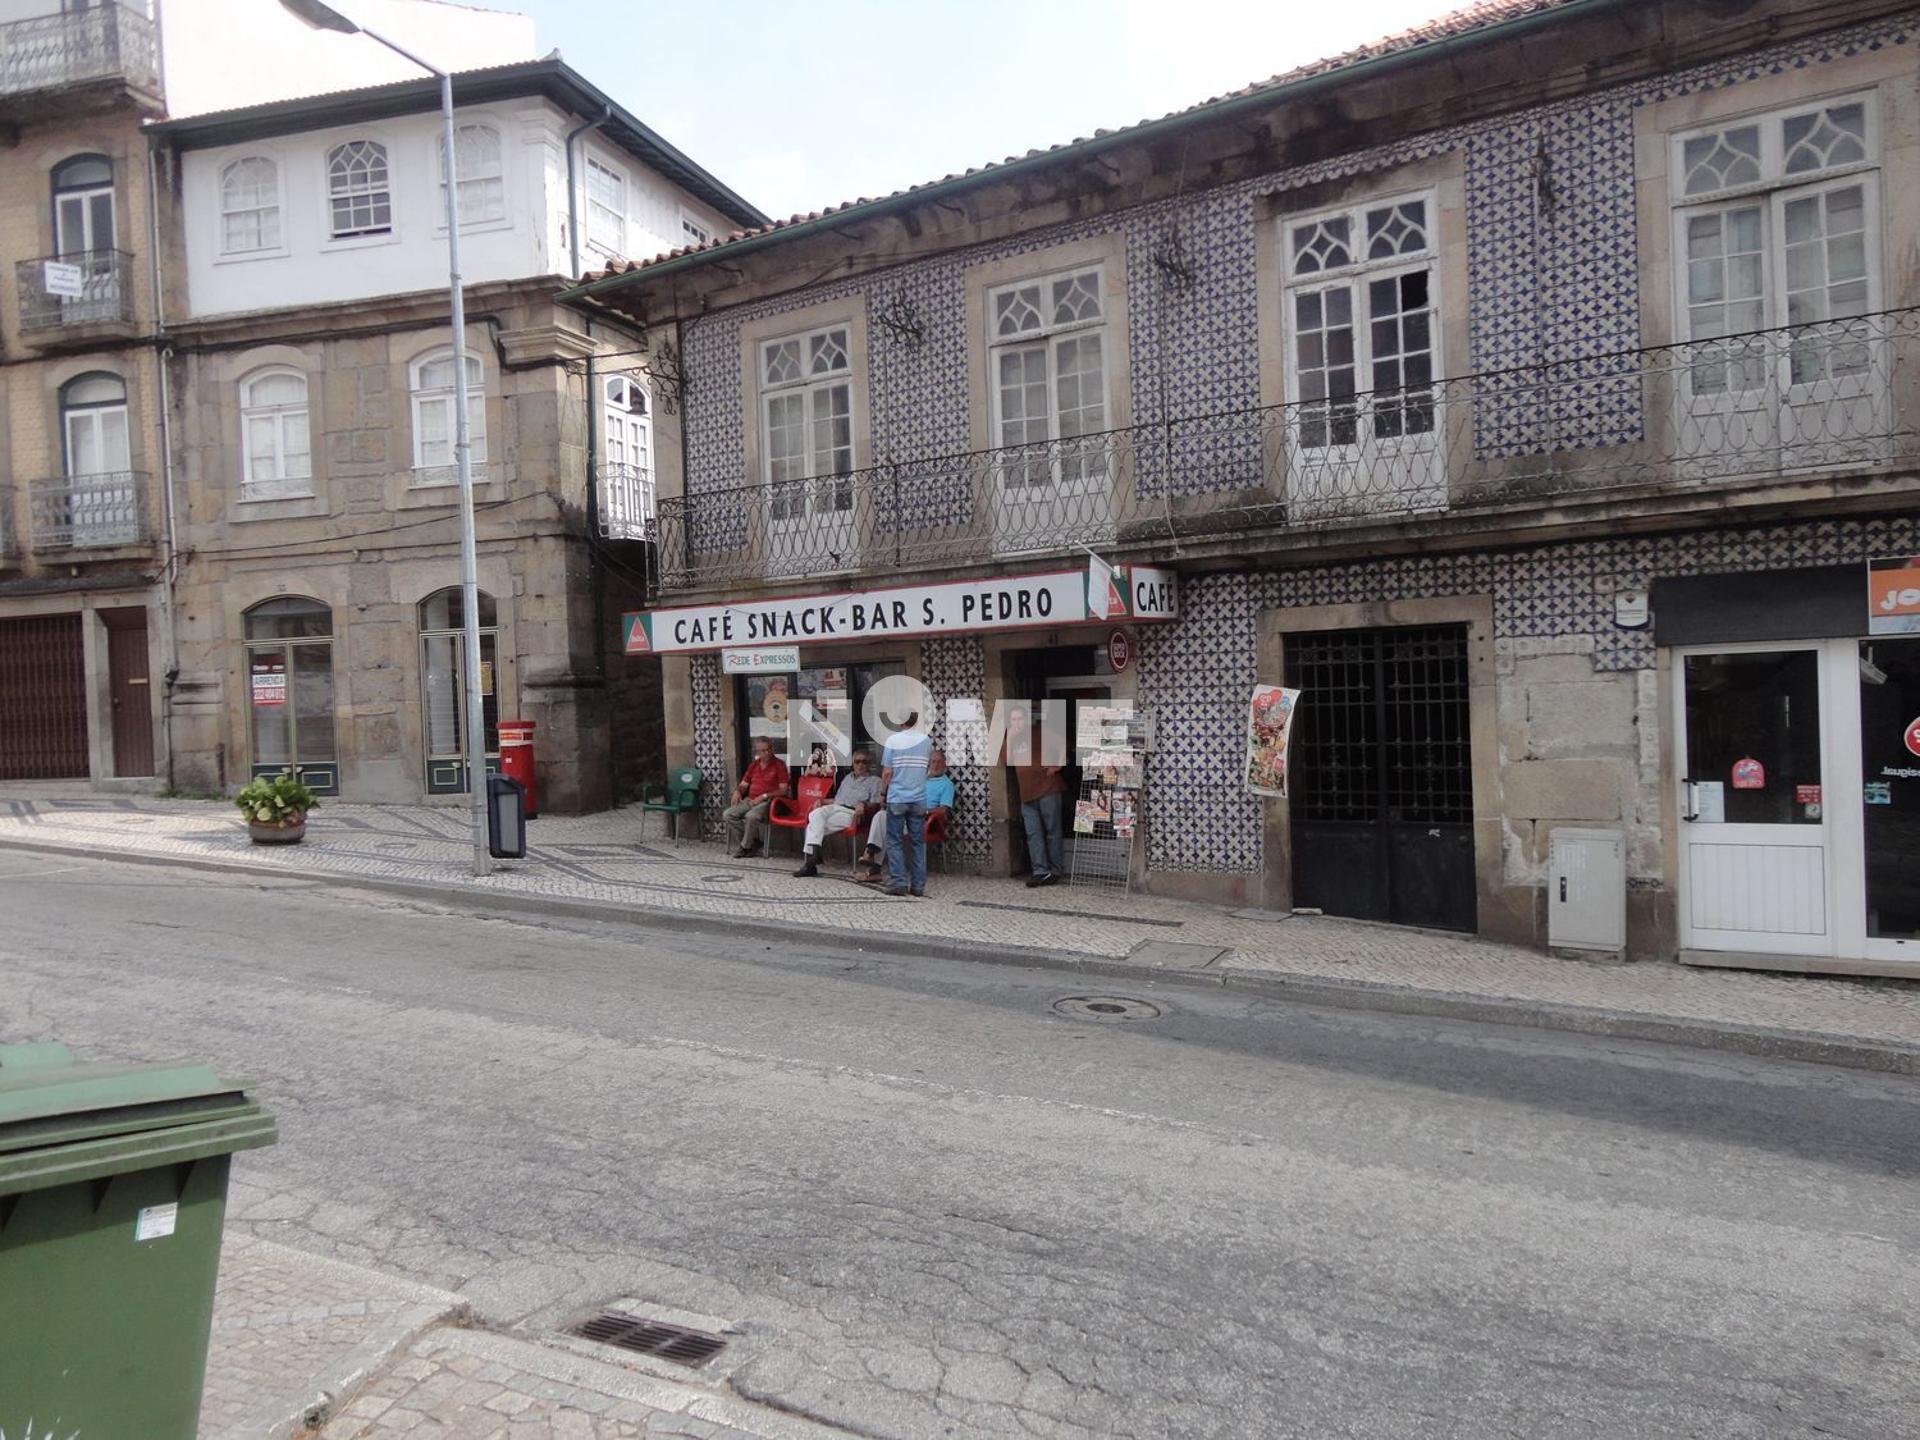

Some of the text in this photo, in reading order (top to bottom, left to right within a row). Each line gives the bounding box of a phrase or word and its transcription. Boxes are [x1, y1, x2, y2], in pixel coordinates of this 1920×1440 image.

[674, 587, 1052, 645] CAFÉ SNACK-BAR S. PEDRO
[1136, 576, 1174, 612] CAFÉ
